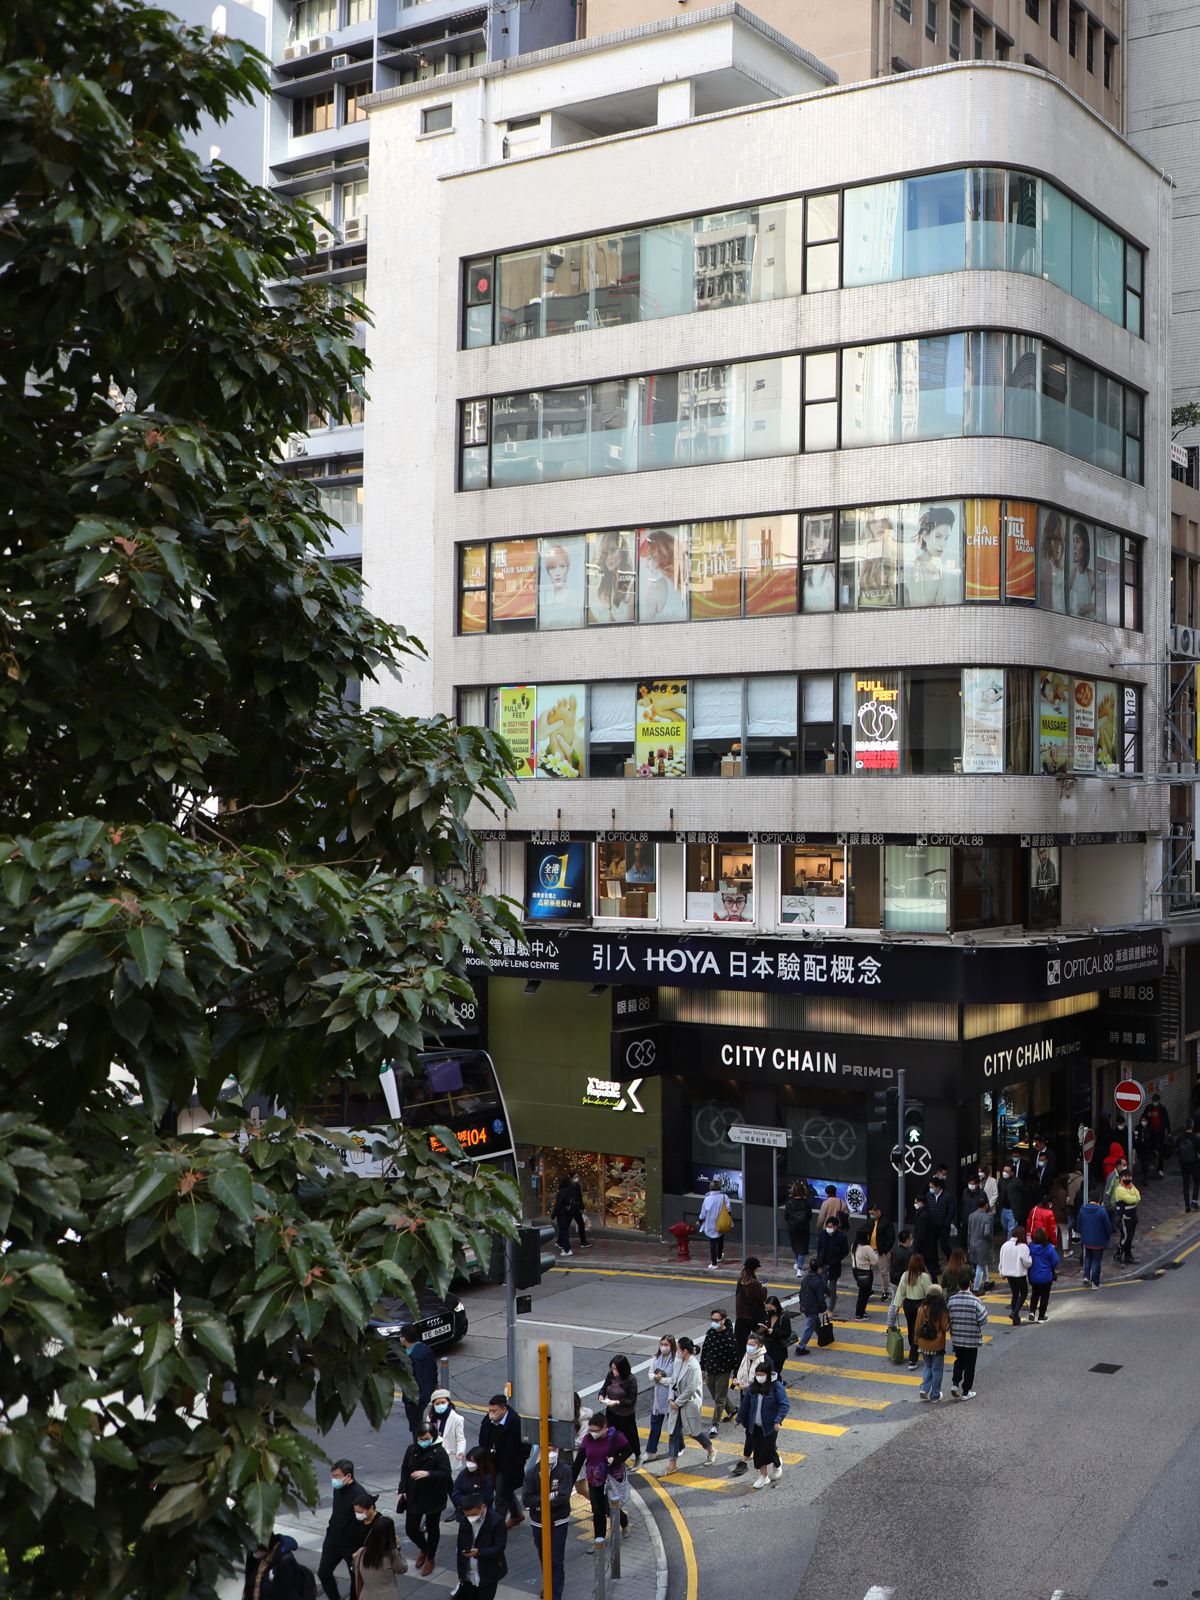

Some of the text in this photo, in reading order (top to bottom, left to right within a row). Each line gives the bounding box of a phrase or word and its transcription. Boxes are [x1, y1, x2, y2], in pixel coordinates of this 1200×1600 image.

[976, 525, 989, 535] LA
[966, 535, 998, 546] CHINE
[1015, 538, 1030, 546] HAIR
[1042, 719, 1067, 732] MASSAGE
[642, 726, 682, 738] MASSAGE
[474, 831, 497, 841] PTICAL
[608, 832, 649, 842] OPTICAL 88
[761, 834, 806, 844] OPTICAL 88
[930, 835, 984, 846] OPTICAL 88
[544, 863, 560, 874] 全港
[592, 944, 636, 972] 引入
[642, 948, 721, 975] HOYA
[510, 960, 529, 969] LENS
[530, 962, 560, 971] CENTRE
[730, 951, 882, 985] 日本驗配概念
[1063, 953, 1114, 980] OPTICAL 88
[460, 1002, 476, 1020] 88
[721, 1044, 894, 1079] CITY CHAIN PRIMO
[984, 1047, 1015, 1077] CITY
[1016, 1039, 1053, 1069] CHAIN
[467, 1127, 487, 1147] 104
